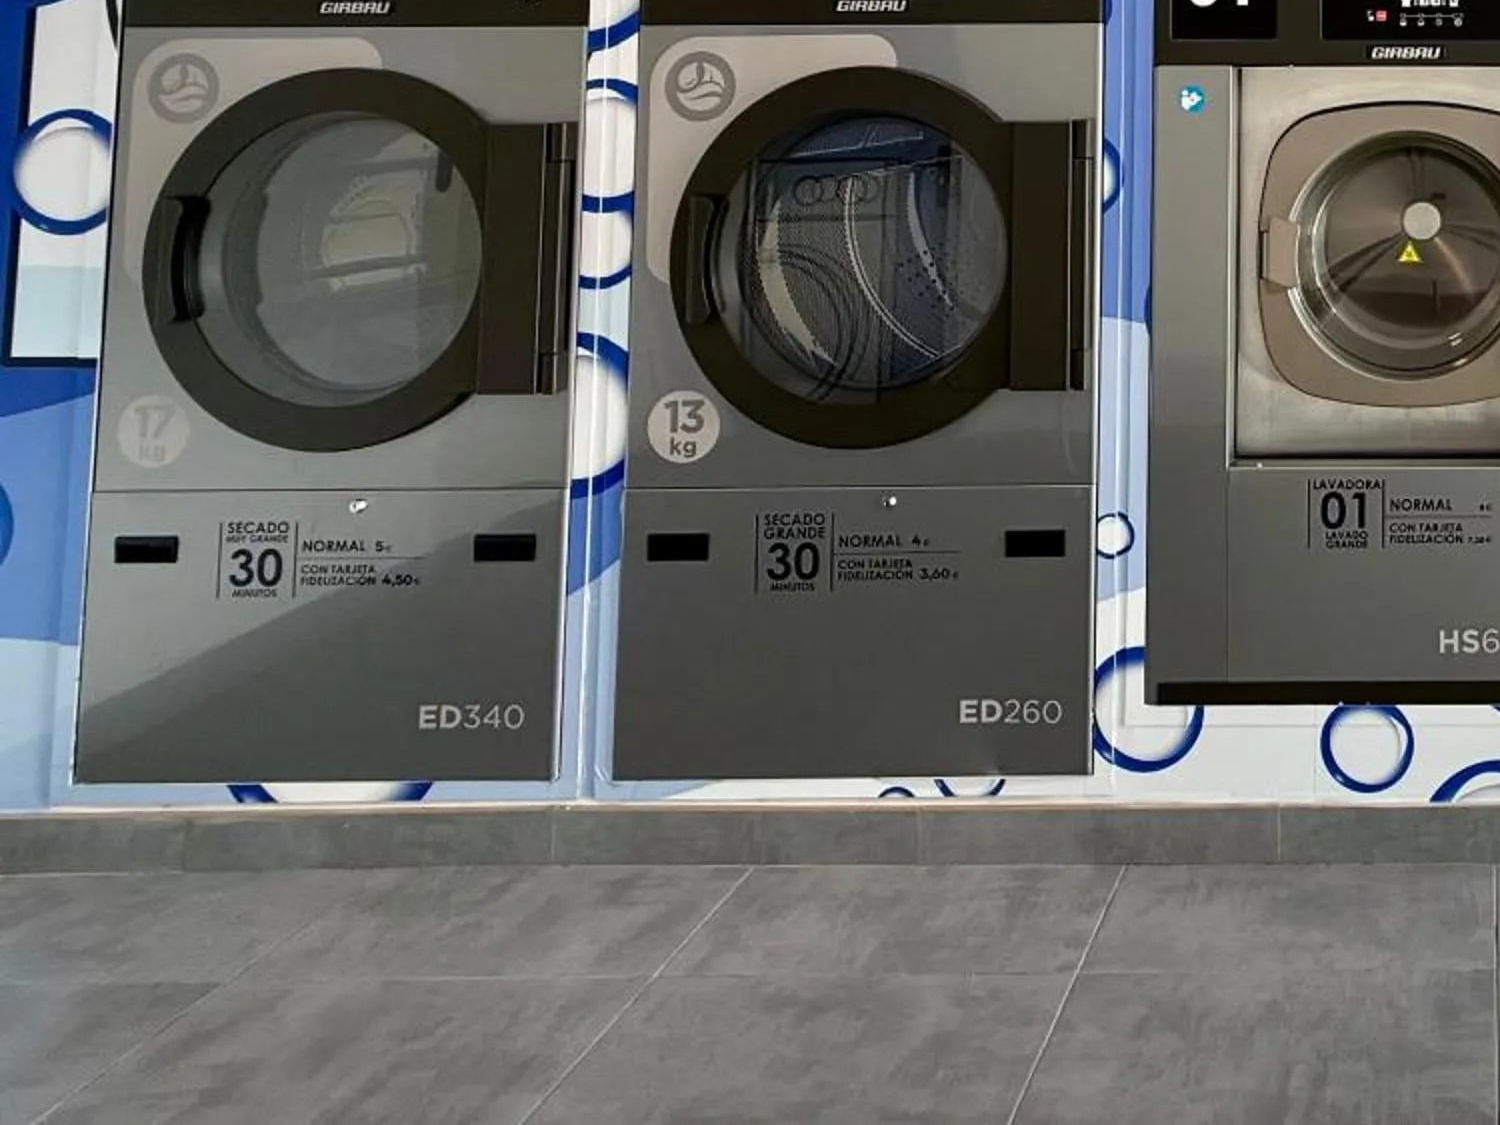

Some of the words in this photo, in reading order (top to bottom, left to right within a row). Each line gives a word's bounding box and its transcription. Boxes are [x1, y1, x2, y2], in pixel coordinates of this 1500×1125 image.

[320, 1, 390, 14] GIRBAU
[836, 0, 907, 12] GIRBAU
[1372, 47, 1441, 59] GIRBAU
[132, 406, 175, 438] 17
[663, 401, 705, 433] 13
[669, 438, 697, 458] kg
[1313, 479, 1381, 489] LAVADORA
[1320, 491, 1366, 529] 01
[1390, 499, 1452, 511] NORMAL
[764, 514, 825, 526] SECADO
[227, 522, 289, 533] SECADO
[764, 528, 825, 539] GRANDE
[1389, 523, 1416, 532] CON
[1419, 523, 1462, 532] TARJETA
[250, 535, 289, 543] GRANDE
[839, 535, 902, 547] NORMAL
[1325, 531, 1368, 539] LAVADO
[302, 541, 365, 552] NORMAL
[767, 542, 820, 581] 30
[838, 560, 865, 569] CON
[869, 559, 912, 568] TARJETA
[229, 549, 283, 587] 30
[301, 564, 328, 574] CON
[332, 565, 375, 573] TARJETA
[232, 589, 277, 597] MINUTOS
[771, 583, 815, 591] MINUTOS
[417, 705, 525, 730] ED340
[958, 700, 1063, 725] ED260
